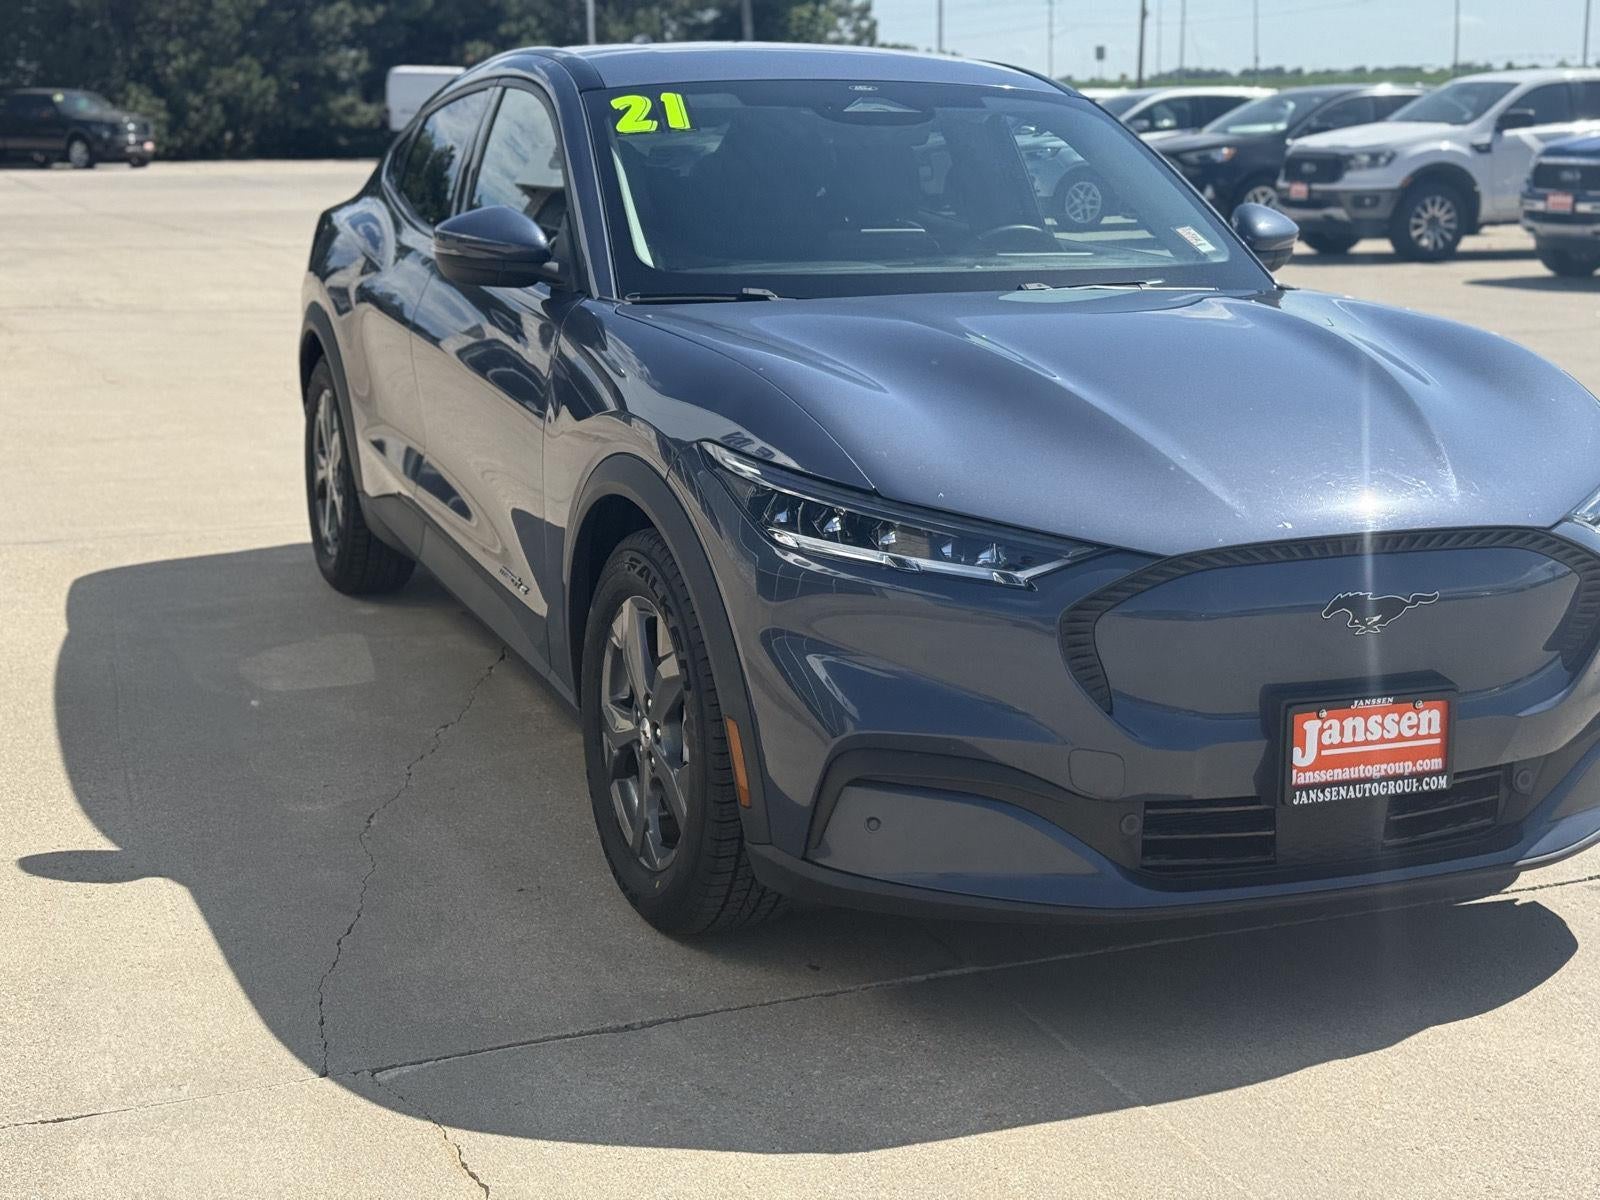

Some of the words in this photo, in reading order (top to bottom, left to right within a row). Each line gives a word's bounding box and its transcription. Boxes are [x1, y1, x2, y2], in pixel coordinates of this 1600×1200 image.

[610, 92, 691, 134] 21
[625, 556, 691, 691] FALKEN
[1350, 696, 1394, 710] JANSSEN
[1292, 707, 1441, 768] Janssen
[1292, 775, 1448, 806] JANSSENAUTOGROUP.COM
